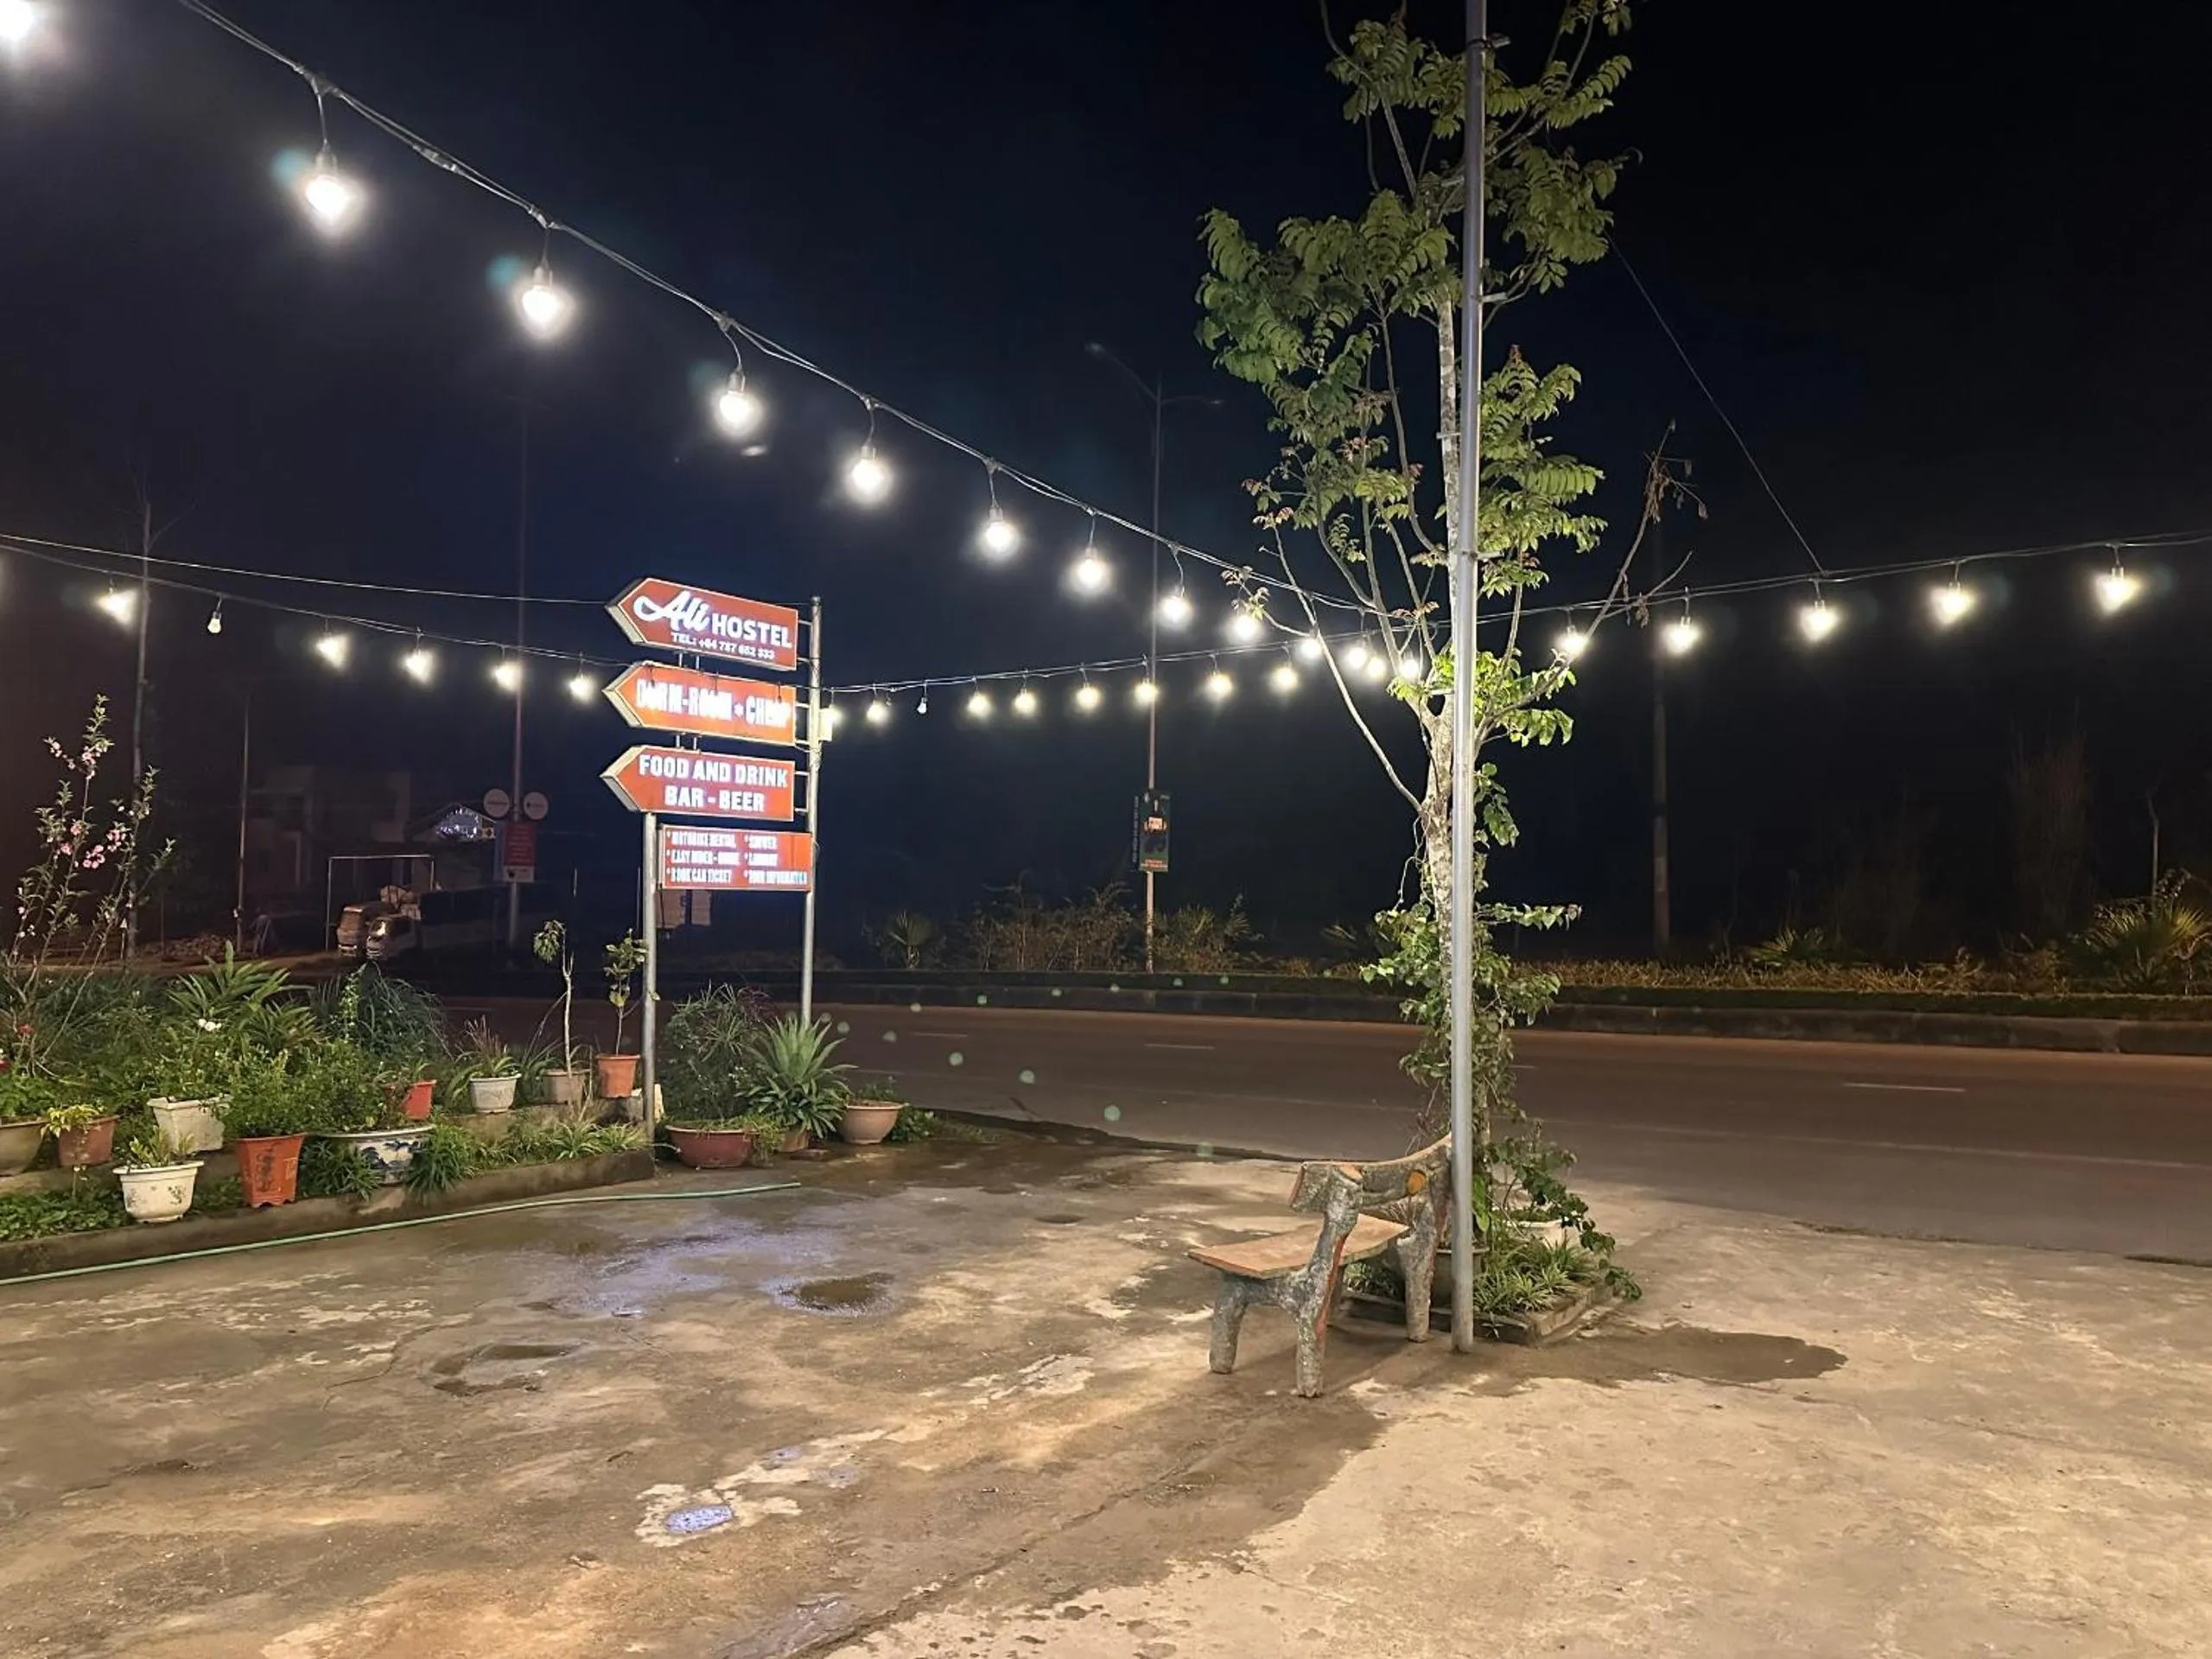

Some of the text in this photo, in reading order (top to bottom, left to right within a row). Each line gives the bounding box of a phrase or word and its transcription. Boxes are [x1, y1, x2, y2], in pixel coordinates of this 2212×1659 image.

[633, 590, 792, 648] Ali HOSTEL
[671, 632, 696, 645] TEL:
[639, 754, 788, 788] FOOD AND DRINK
[664, 785, 704, 808] BAR
[719, 790, 765, 811] BEER
